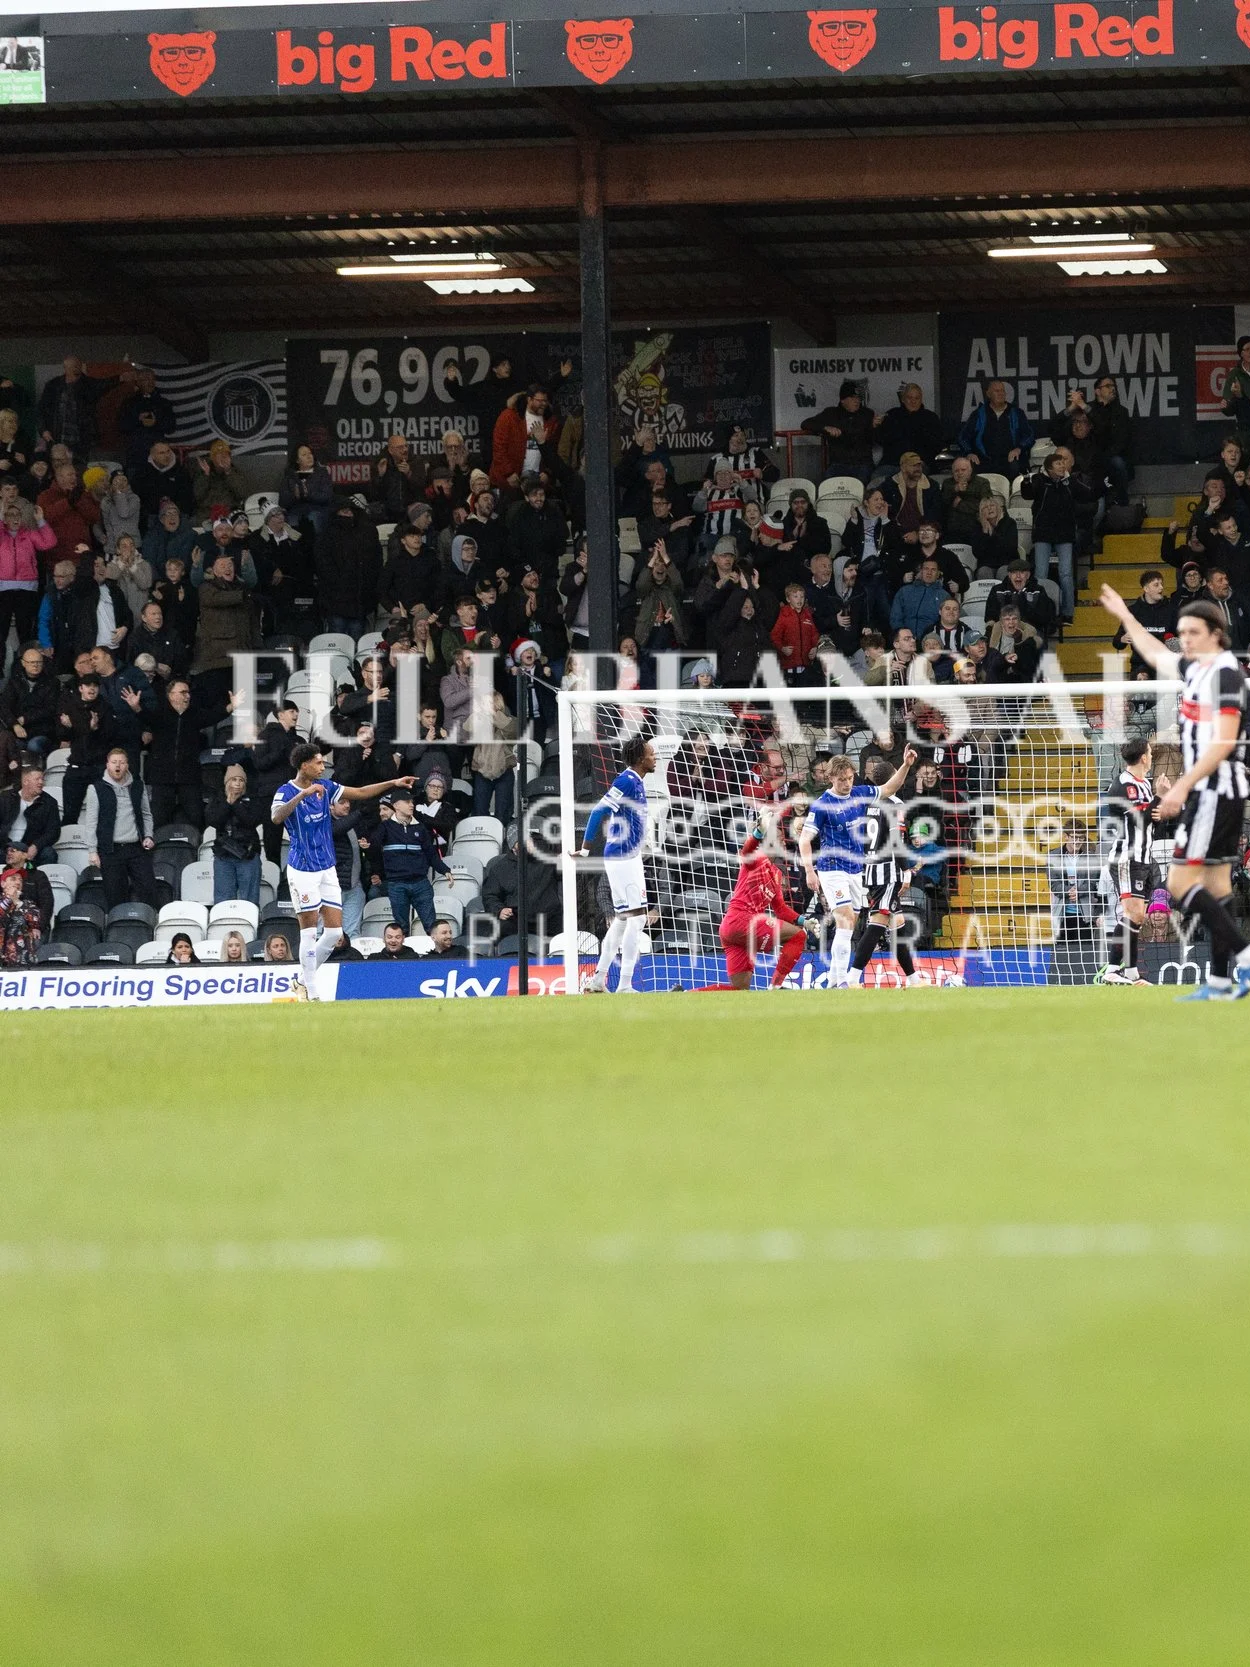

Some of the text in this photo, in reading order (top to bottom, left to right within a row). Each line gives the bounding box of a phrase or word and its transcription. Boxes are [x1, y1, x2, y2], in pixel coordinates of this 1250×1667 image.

[939, 0, 1174, 69] big Red
[277, 23, 507, 92] big Red
[789, 357, 923, 374] GRIMSBY TOWN FC
[967, 332, 1171, 378] ALL TOWN
[1116, 376, 1180, 418] WE
[336, 414, 480, 440] OLD TRAFFORD
[666, 431, 714, 449] VIKINGS
[1071, 760, 1081, 773] H
[866, 818, 879, 850] 9
[39, 974, 154, 1001] Flooring
[420, 970, 501, 998] sky
